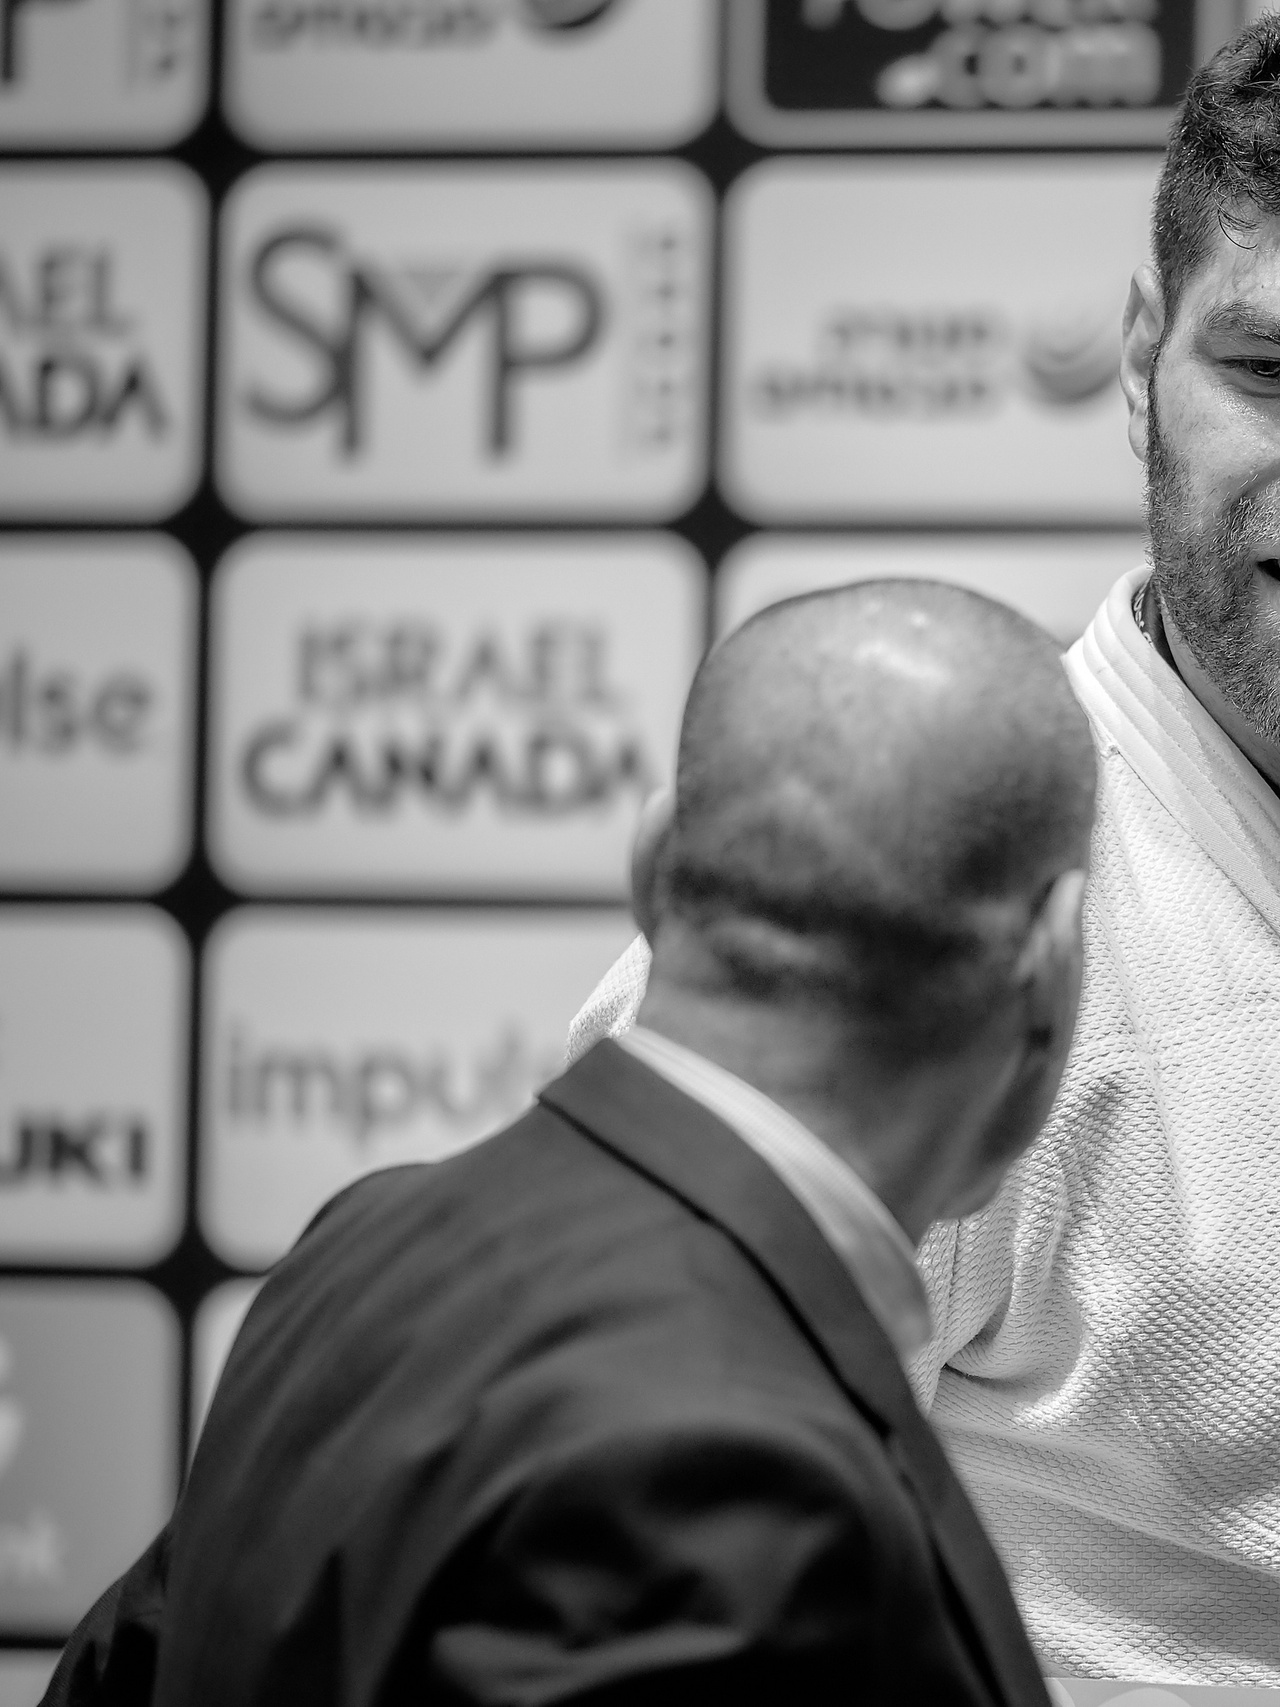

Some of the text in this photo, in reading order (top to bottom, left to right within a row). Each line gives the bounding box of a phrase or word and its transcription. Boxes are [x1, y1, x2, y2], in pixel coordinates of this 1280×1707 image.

[243, 215, 609, 468] SMP
[296, 614, 630, 712] ISRAEL
[241, 715, 658, 824] CANADA
